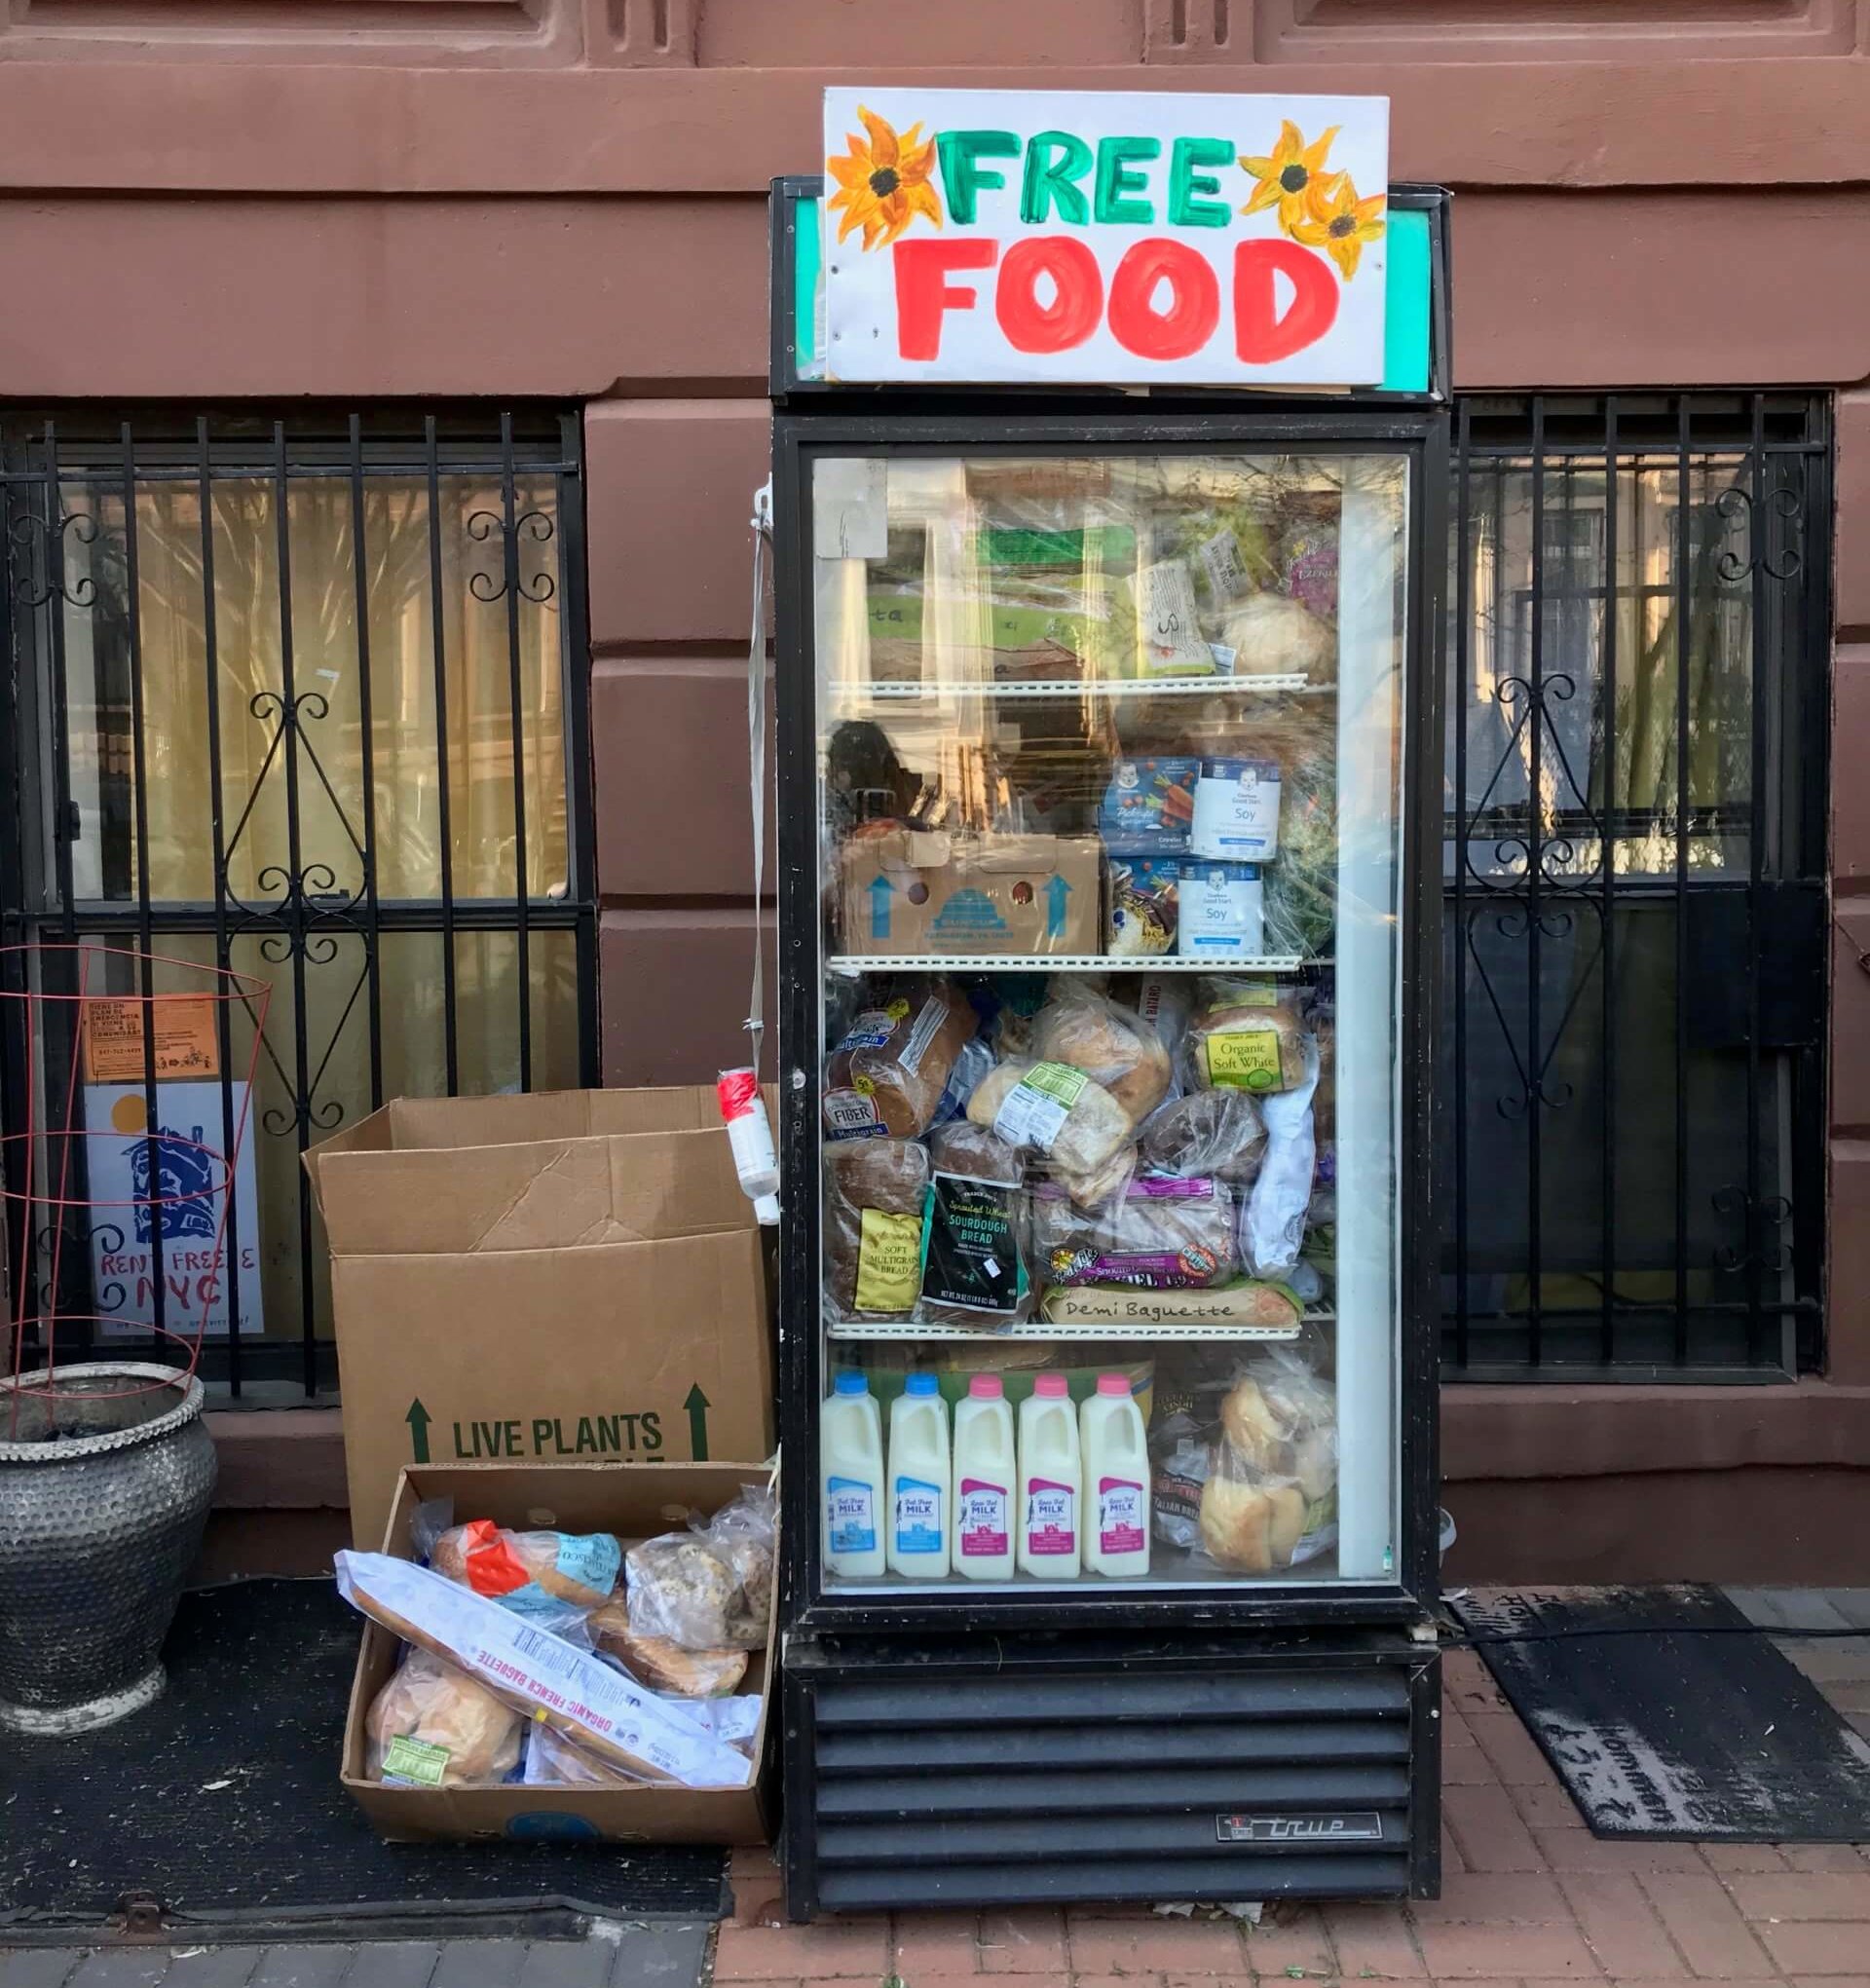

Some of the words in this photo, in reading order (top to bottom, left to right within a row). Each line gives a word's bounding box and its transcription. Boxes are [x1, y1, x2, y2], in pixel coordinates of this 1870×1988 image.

[935, 130, 1236, 227] FREE
[893, 235, 1340, 365] FOOD
[1235, 807, 1256, 822] Soy
[1206, 908, 1228, 921] Soy
[1220, 1042, 1265, 1056] Organic
[1214, 1057, 1238, 1069] Soft
[1240, 1056, 1276, 1069] White
[834, 1106, 872, 1124] FIBER
[949, 1214, 1008, 1235] SOURDOUGH
[960, 1229, 993, 1244] BREAD
[884, 1246, 907, 1255] SOFT
[171, 1248, 255, 1271] FREEE
[880, 1265, 909, 1275] BREAD
[136, 1275, 222, 1310] NYC
[1066, 1301, 1118, 1316] Demi
[1125, 1301, 1235, 1322] Baguette
[453, 1420, 525, 1459] LIVE
[532, 1411, 663, 1455] PLANTS
[839, 1504, 864, 1513] MILK
[906, 1505, 932, 1514] MILK
[971, 1506, 996, 1515] MILK
[1038, 1505, 1065, 1514] MILK
[1109, 1503, 1135, 1512] MILK
[476, 1649, 528, 1687] BAGUETTE
[528, 1681, 567, 1709] FRENCH
[568, 1704, 614, 1733] ORGANIC
